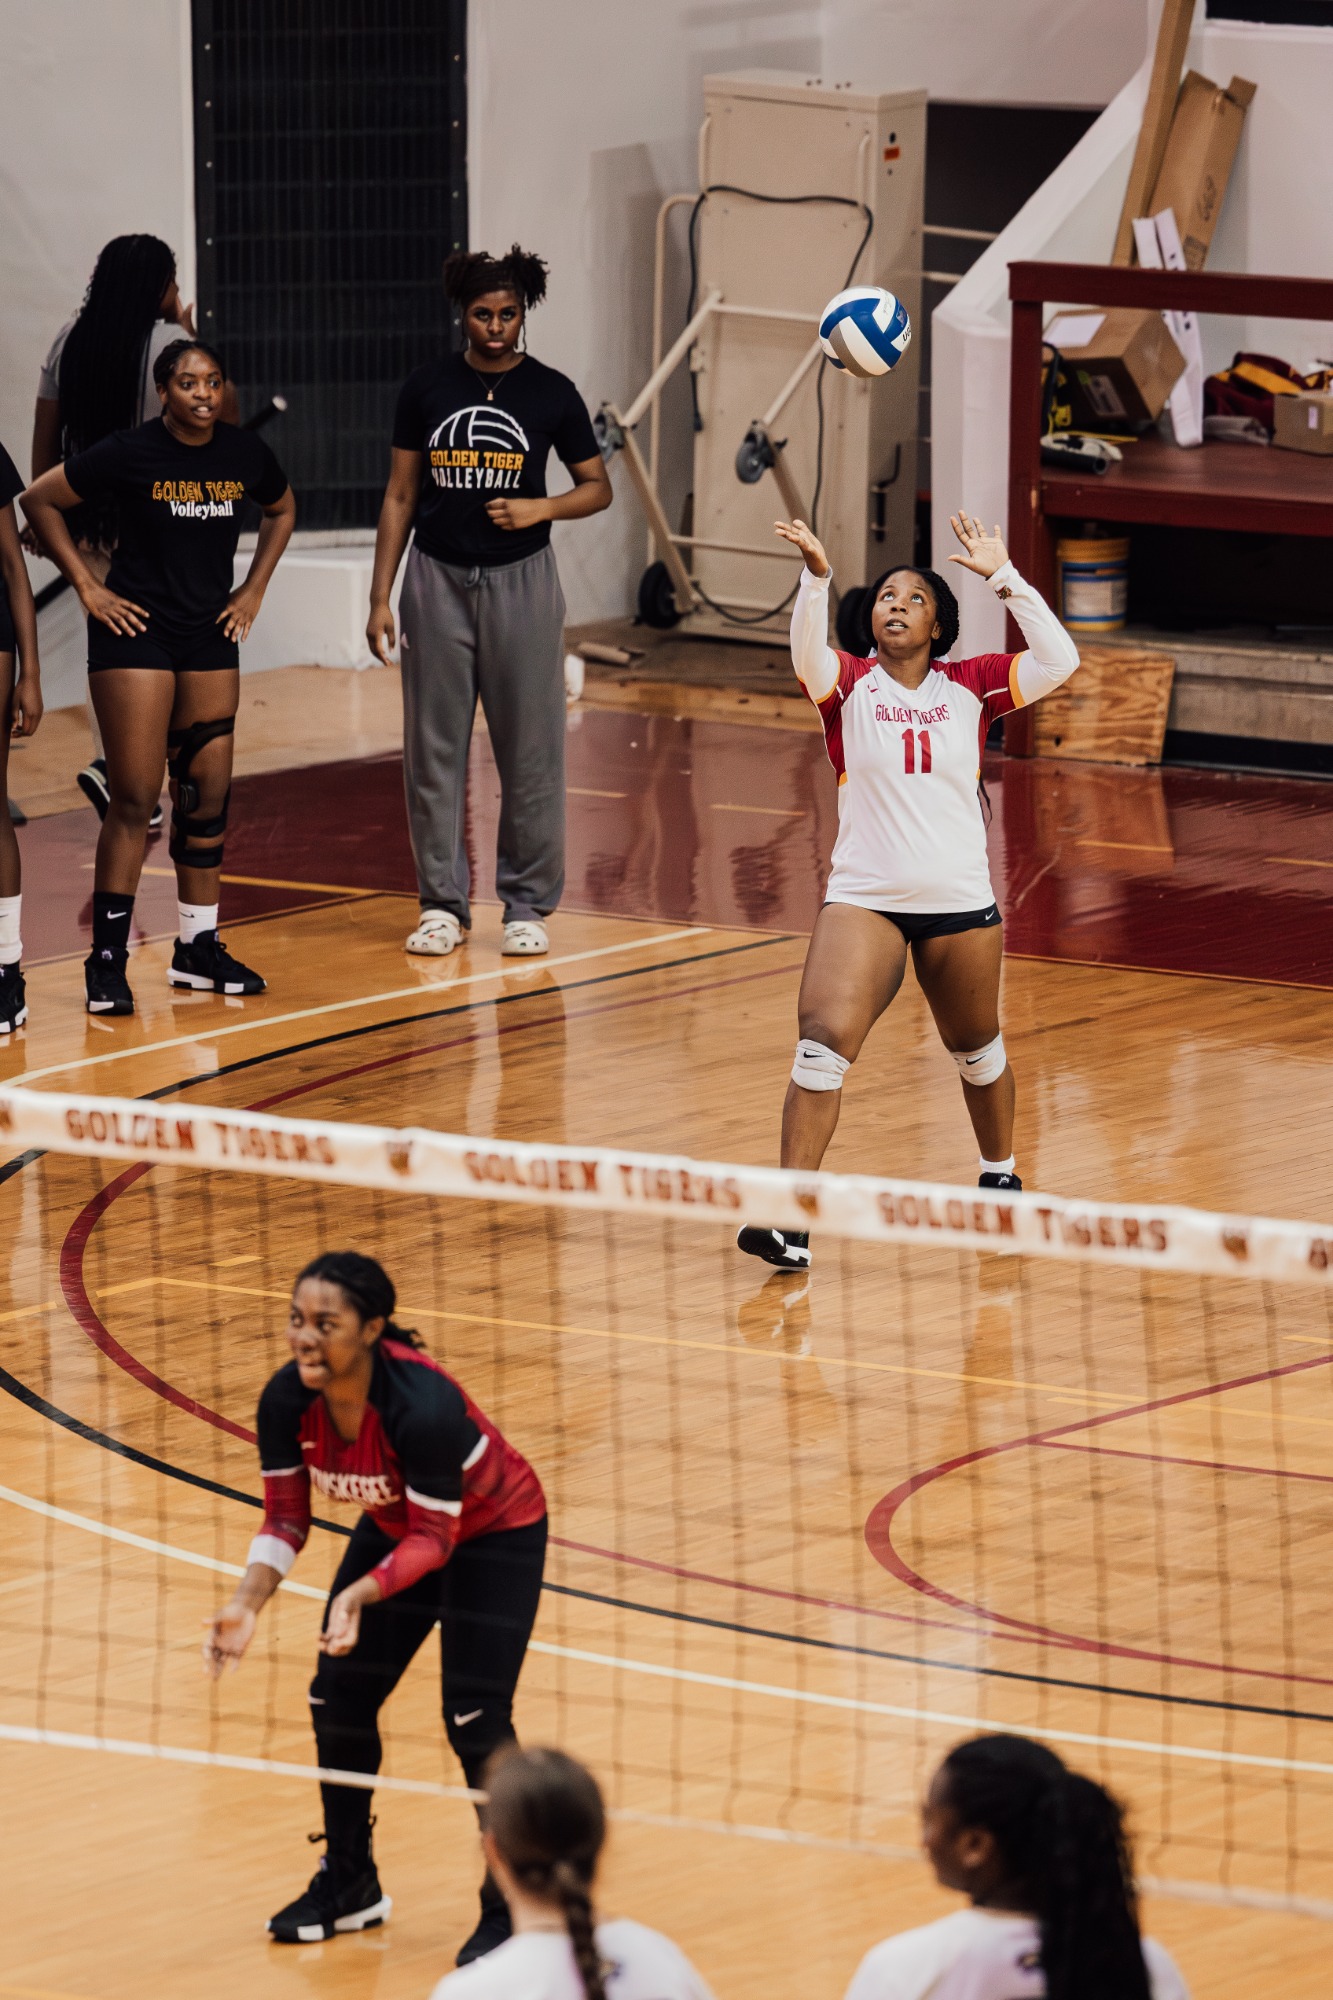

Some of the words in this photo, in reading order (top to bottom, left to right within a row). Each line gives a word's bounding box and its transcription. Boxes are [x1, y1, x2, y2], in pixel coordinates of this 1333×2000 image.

[430, 450, 479, 467] GOLDEN
[483, 451, 524, 470] TIGER
[431, 467, 521, 489] VOLLEYBALL
[152, 480, 204, 502] GOLDEN
[169, 500, 234, 520] Volleyball
[875, 704, 913, 724] GOLDEN
[913, 703, 950, 725] TIGERS
[901, 728, 932, 774] 11
[65, 1108, 196, 1151] GOLDEN
[213, 1120, 335, 1166] TIGERS
[463, 1150, 599, 1192] GOLDEN
[618, 1164, 743, 1210] TIGERS
[878, 1191, 1015, 1236] GOLDEN
[1035, 1207, 1169, 1252] TIGERS
